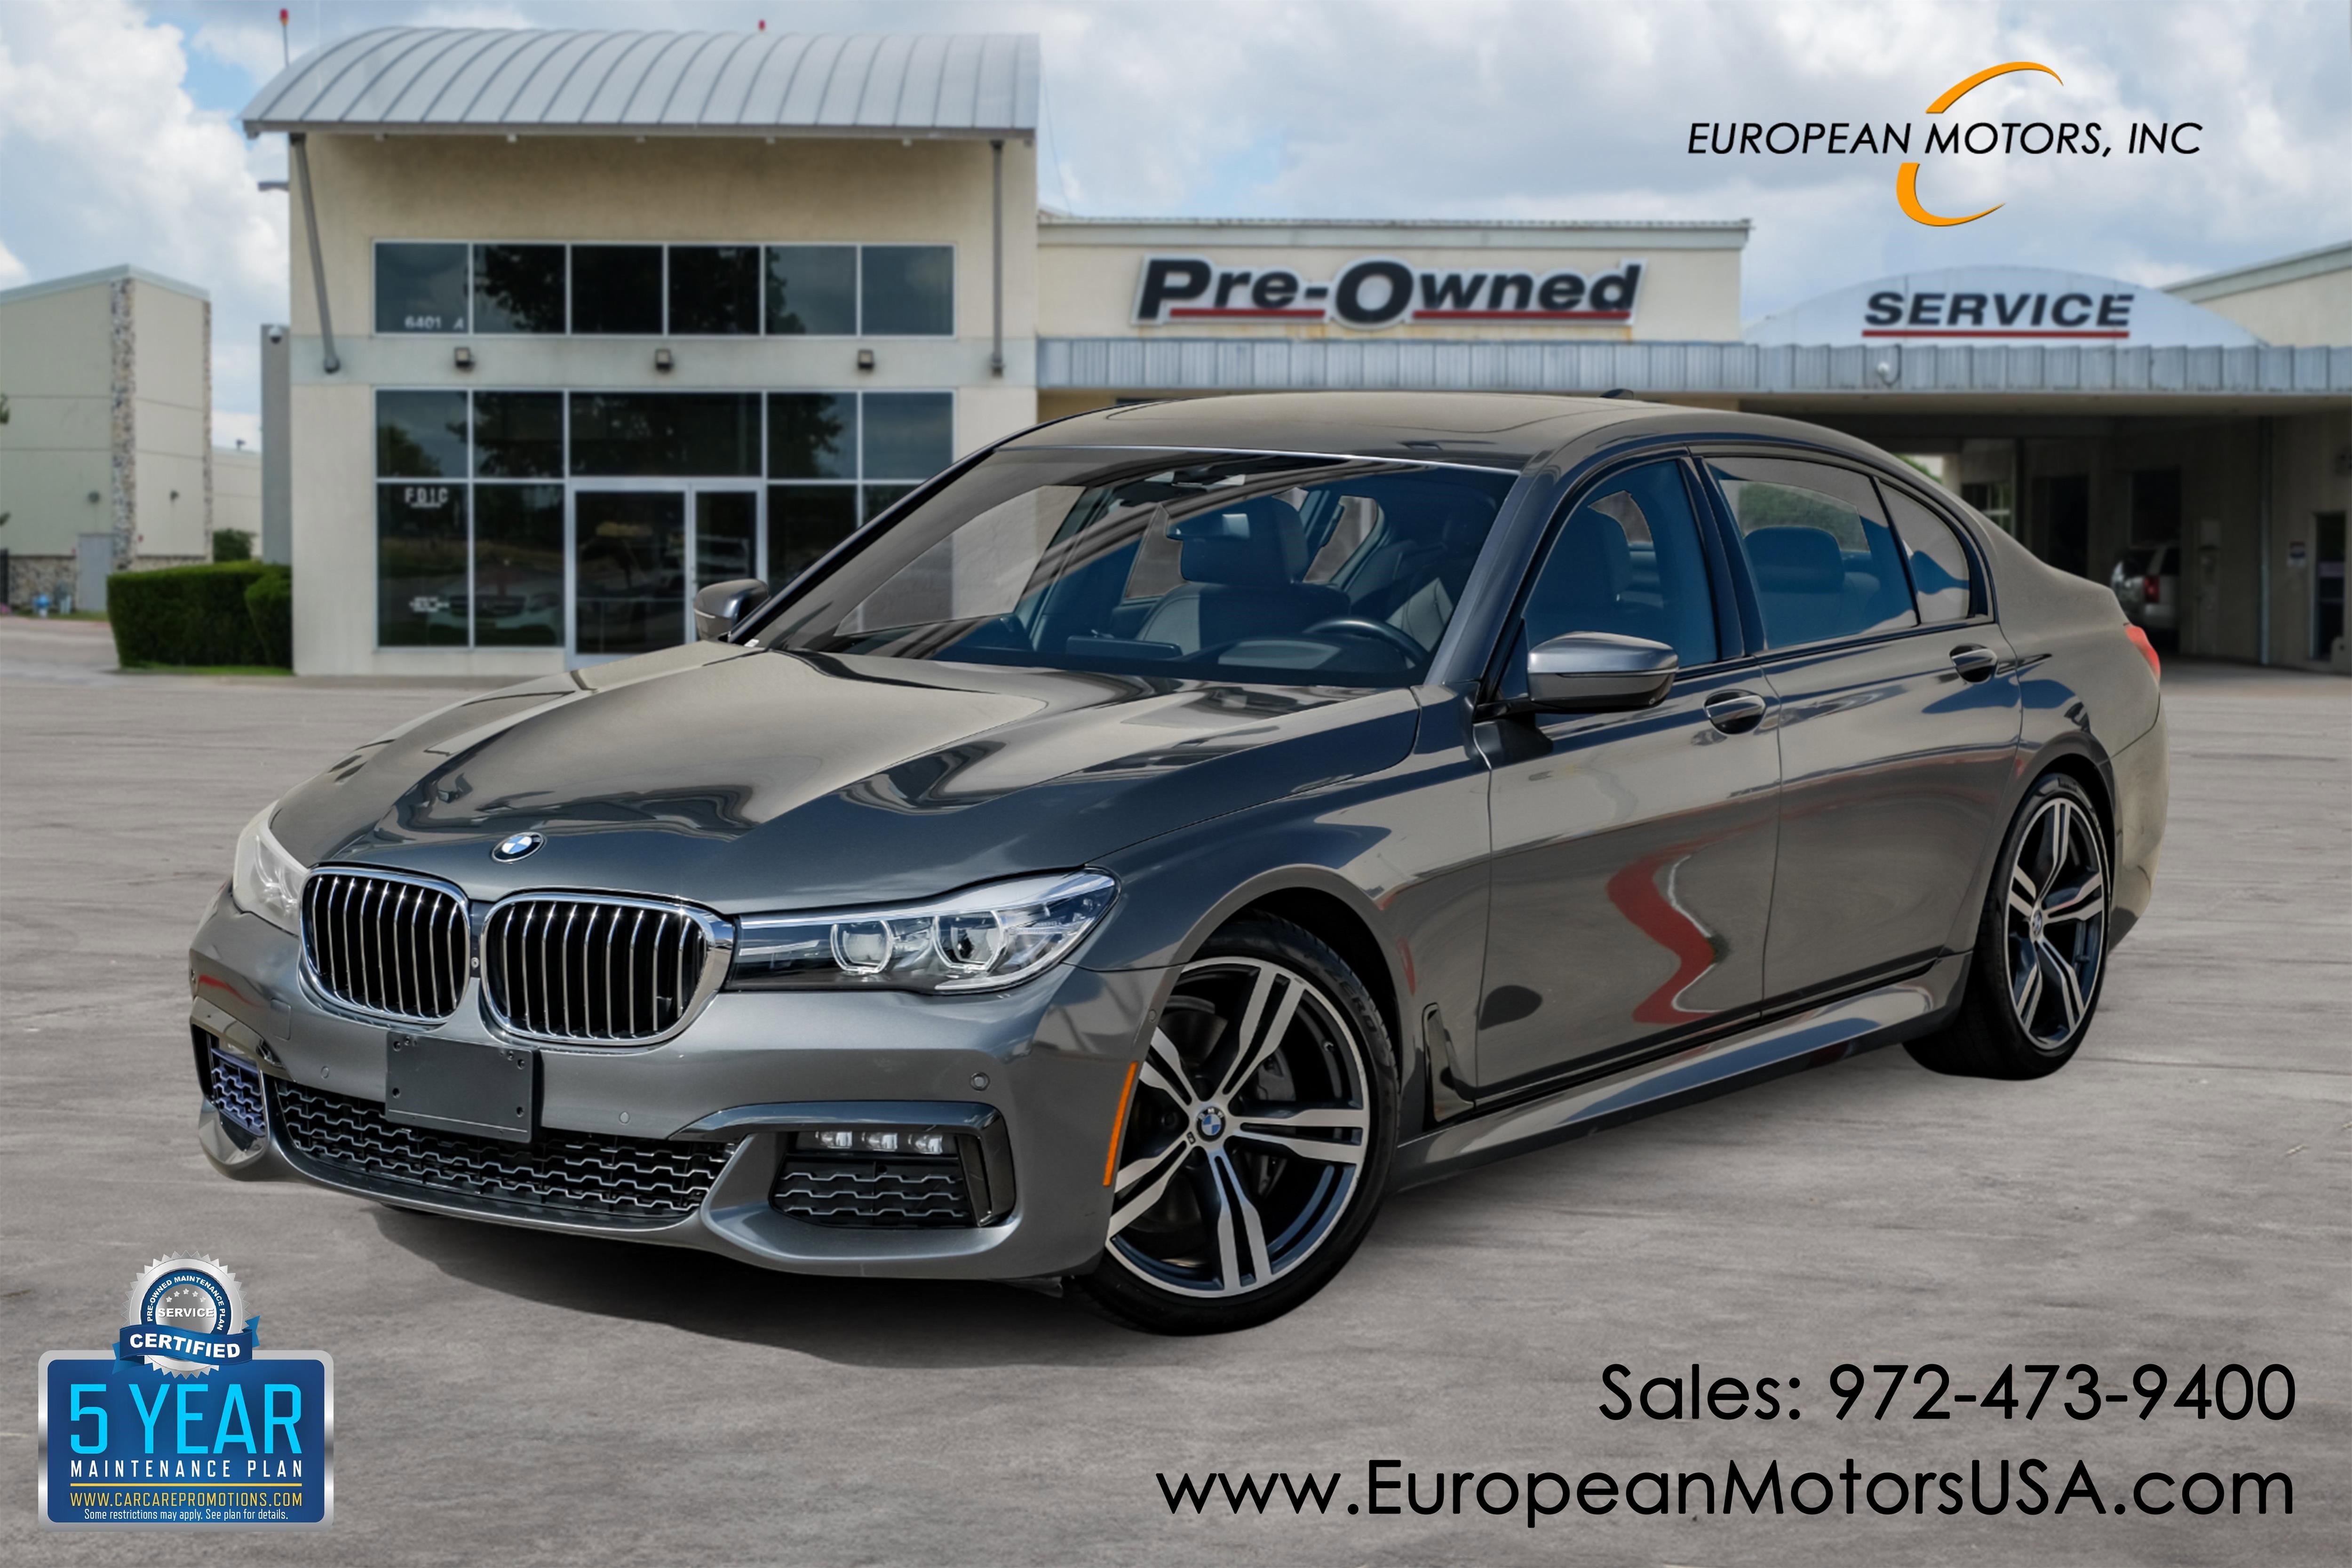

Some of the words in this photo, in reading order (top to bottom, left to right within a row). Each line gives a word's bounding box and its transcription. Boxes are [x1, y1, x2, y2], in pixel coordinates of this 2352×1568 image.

[1138, 259, 1642, 323] Pre-Owned
[404, 315, 441, 329] 6401
[1864, 292, 2134, 327] SERVICE
